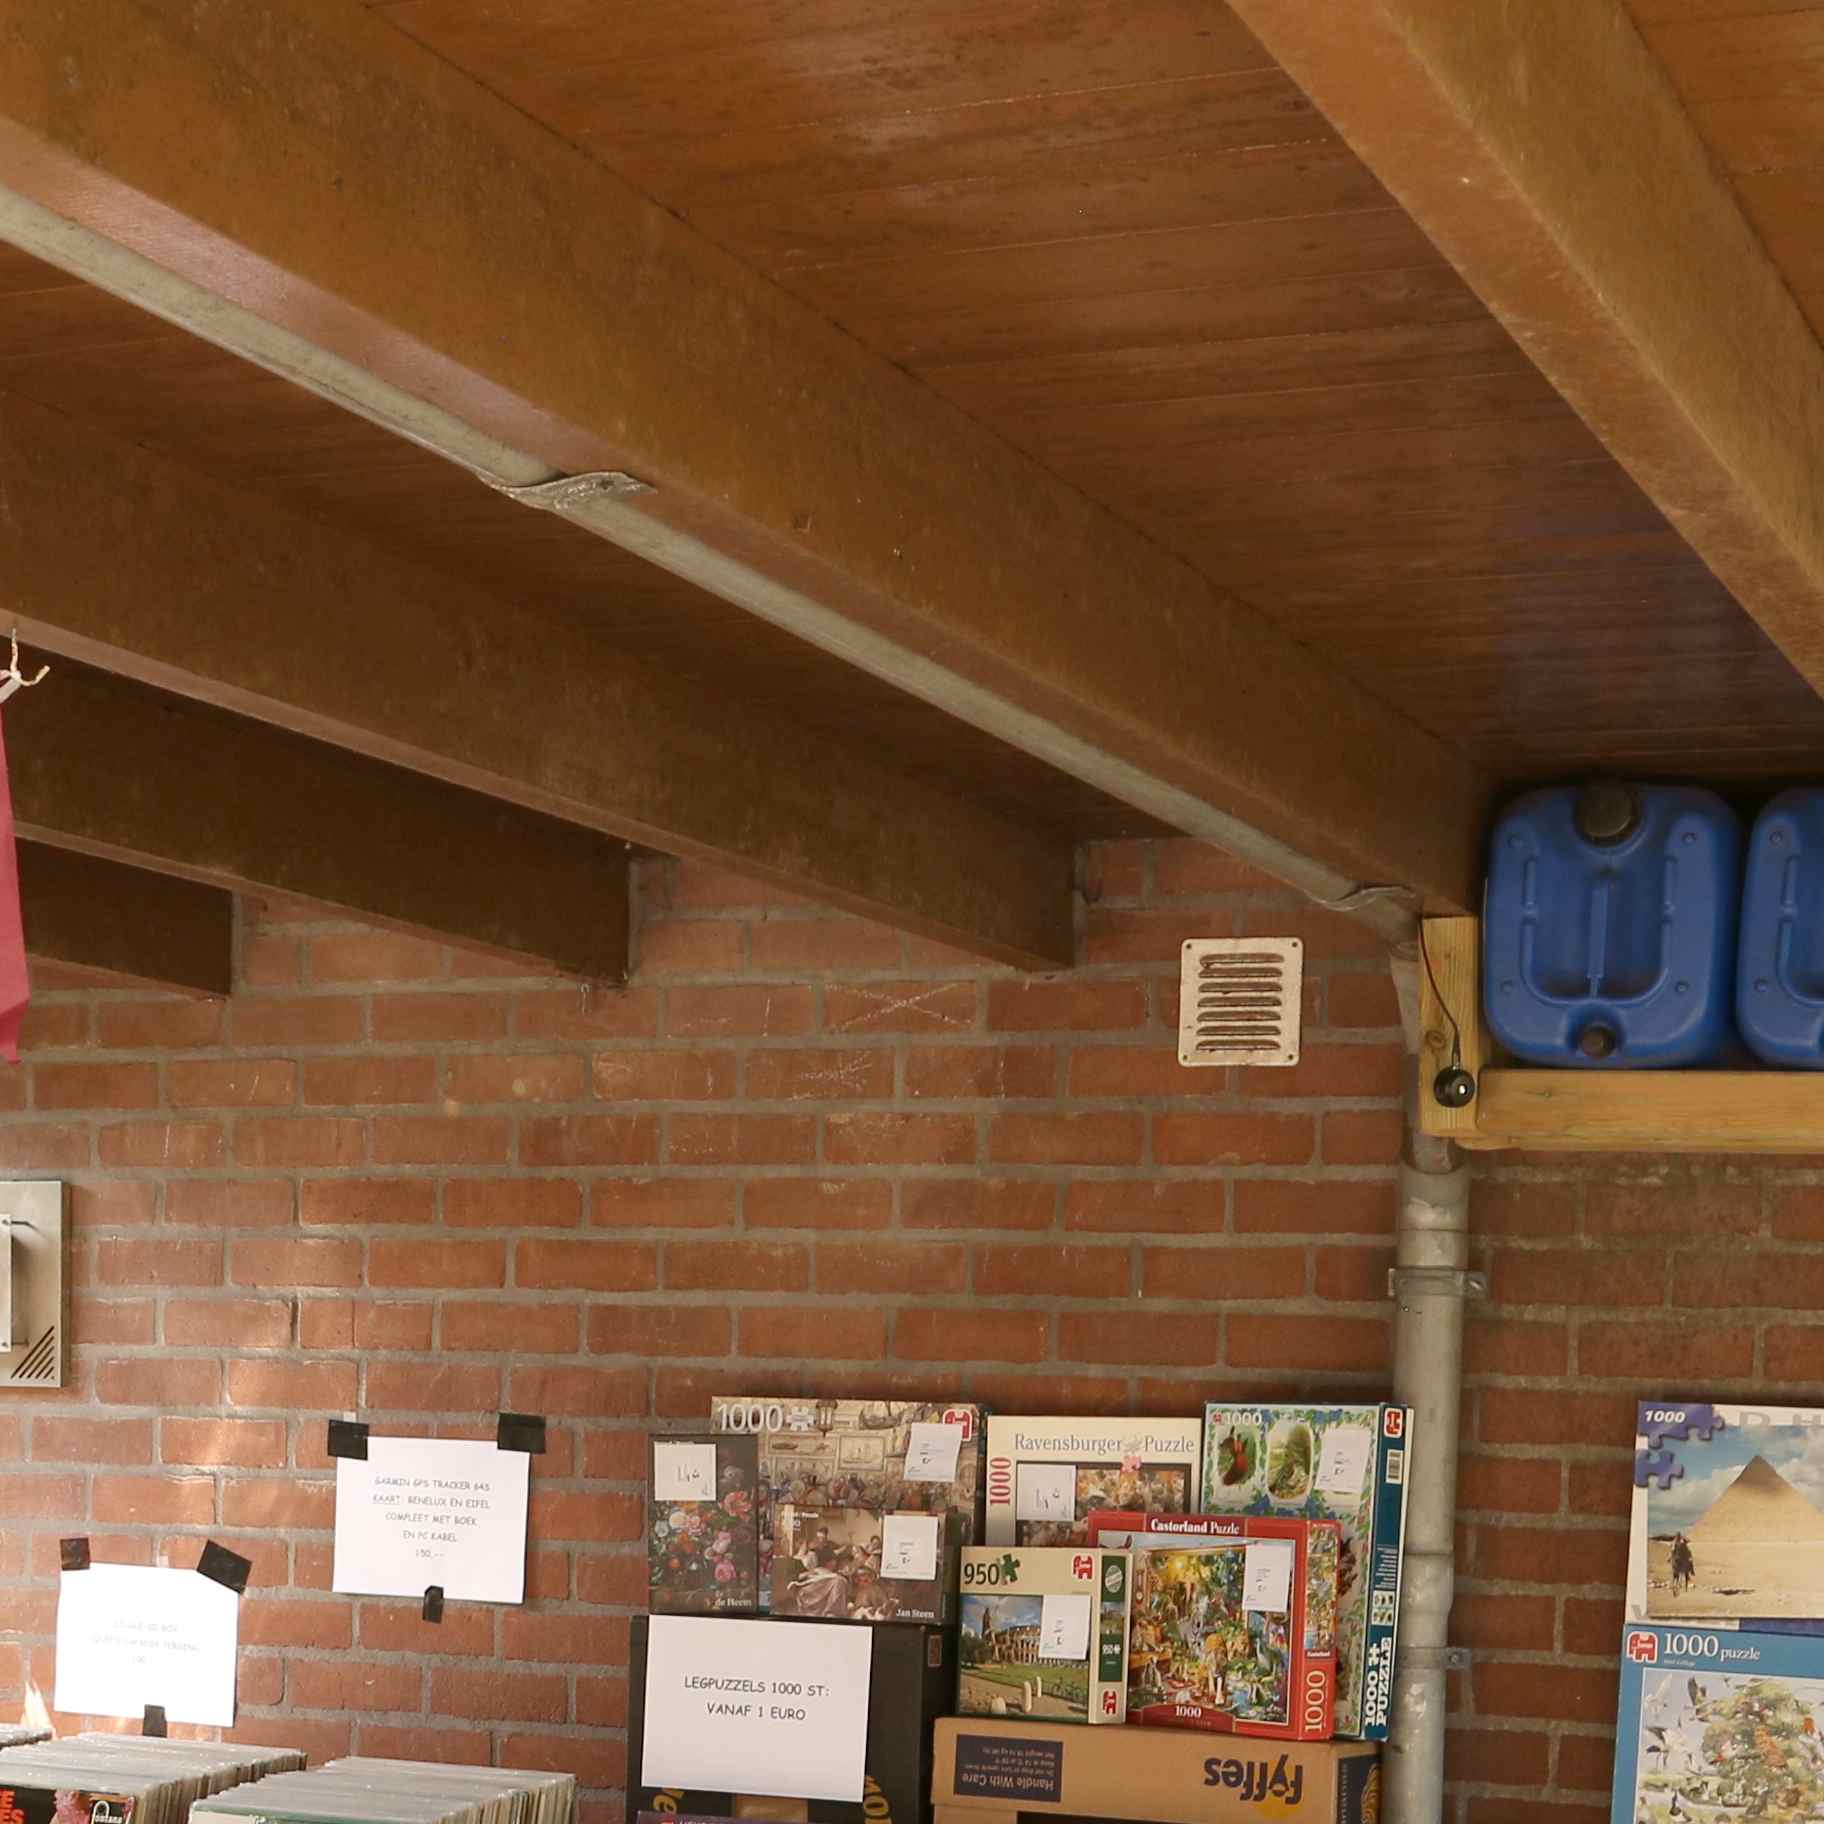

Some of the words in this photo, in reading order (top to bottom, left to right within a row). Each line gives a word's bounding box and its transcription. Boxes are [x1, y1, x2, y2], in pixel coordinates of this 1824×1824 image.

[717, 1404, 784, 1433] 1000
[1225, 1411, 1262, 1426] 1000
[1644, 1410, 1686, 1423] 1000
[1015, 1433, 1122, 1455] Ravensburger
[1144, 1435, 1194, 1453] Puzzle
[432, 1480, 470, 1490] TRACKER
[990, 1457, 1011, 1505] 1000
[408, 1496, 447, 1507] BENELUX
[450, 1498, 462, 1508] EN
[466, 1499, 491, 1509] EIFEL
[385, 1512, 428, 1522] COMPLEET
[433, 1516, 450, 1524] MET
[455, 1517, 477, 1525] BOEK
[1151, 1518, 1207, 1533] Castorland
[1210, 1521, 1240, 1535] Puzzle
[431, 1532, 457, 1542] KABEL
[964, 1563, 1000, 1585] 950
[1664, 1633, 1719, 1658] 1000
[1720, 1647, 1760, 1661] puzzle
[684, 1675, 766, 1693] LEGPUZZELS
[772, 1683, 802, 1695] 1000
[808, 1685, 830, 1697] ST:
[1377, 1637, 1392, 1726] PUZZLE
[1304, 1670, 1326, 1733] 1000
[1365, 1671, 1378, 1726] 1000
[707, 1702, 752, 1717] VANAF
[758, 1707, 764, 1717] 1
[771, 1707, 806, 1720] EURO
[1176, 1706, 1202, 1718] 1000
[961, 1773, 987, 1786] Care
[990, 1775, 1014, 1788] With
[1016, 1776, 1055, 1791] Handle
